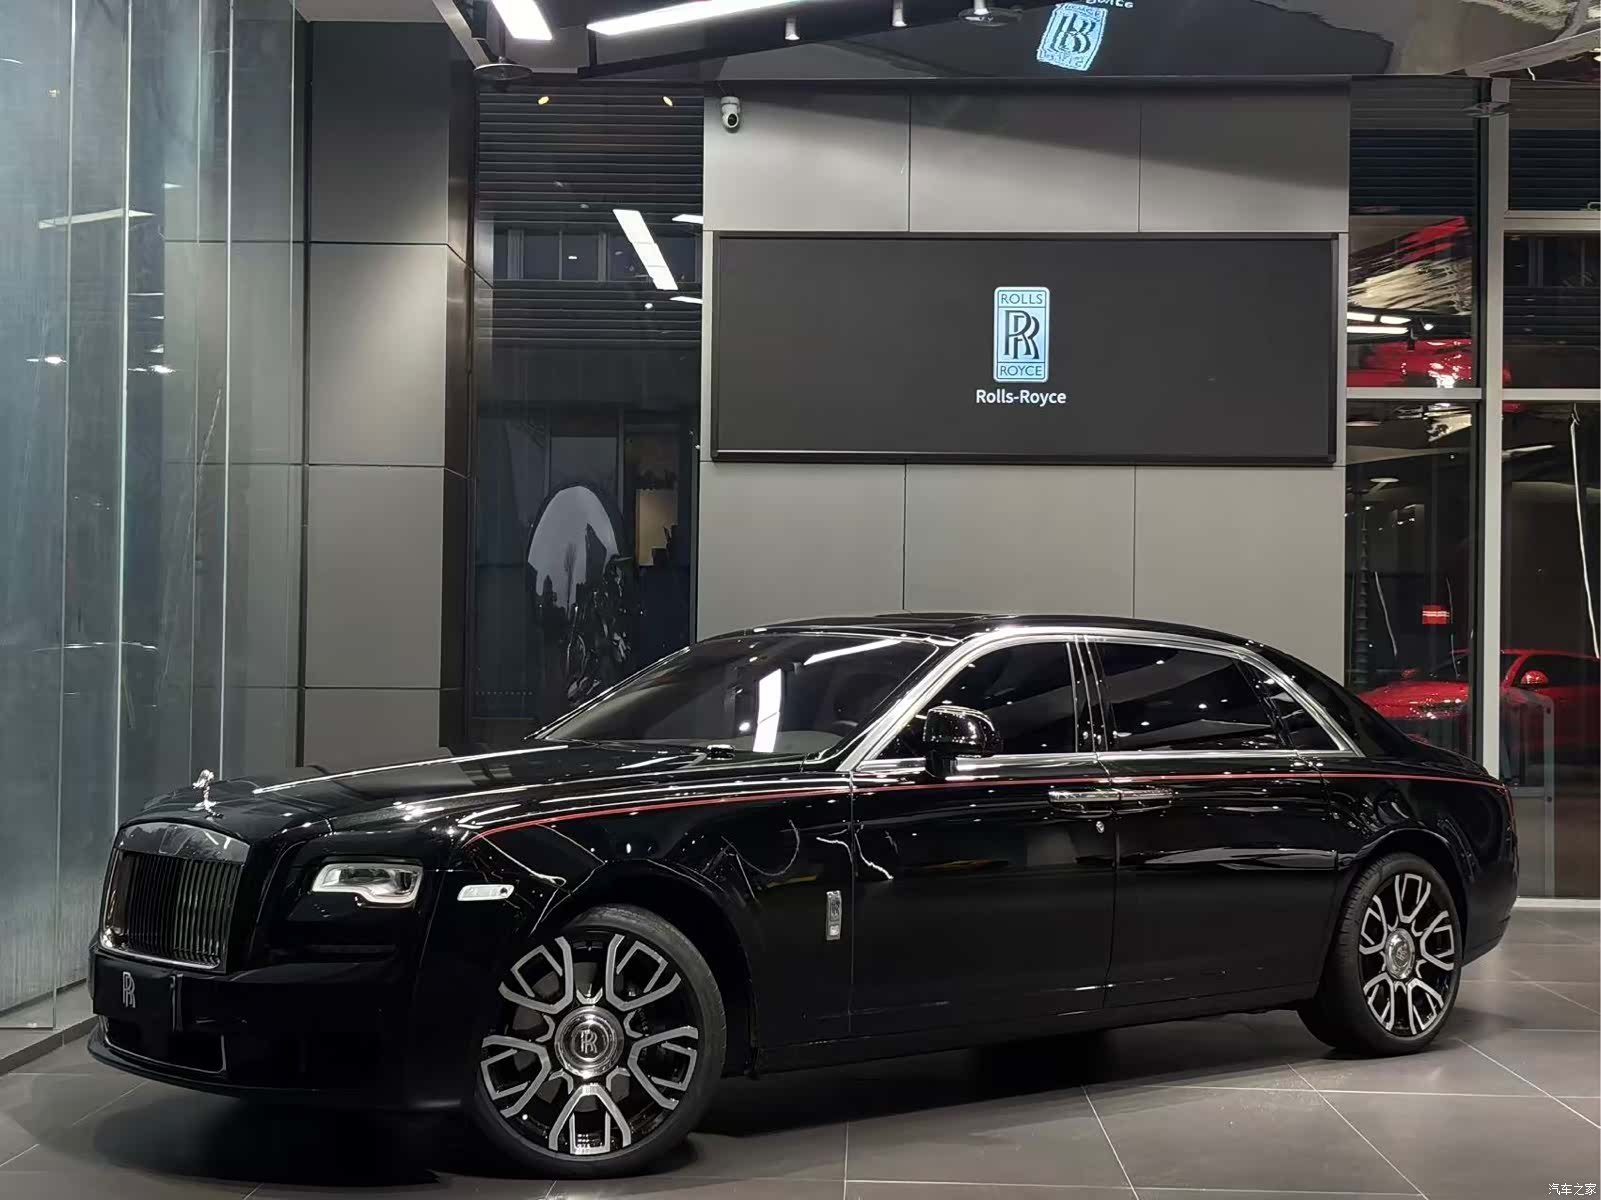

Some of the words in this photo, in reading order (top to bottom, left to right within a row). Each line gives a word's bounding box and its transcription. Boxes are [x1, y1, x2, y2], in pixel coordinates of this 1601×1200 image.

[1000, 293, 1043, 305] ROLLS
[1000, 365, 1043, 376] ROYCE
[975, 388, 1067, 407] Rolls-Royce
